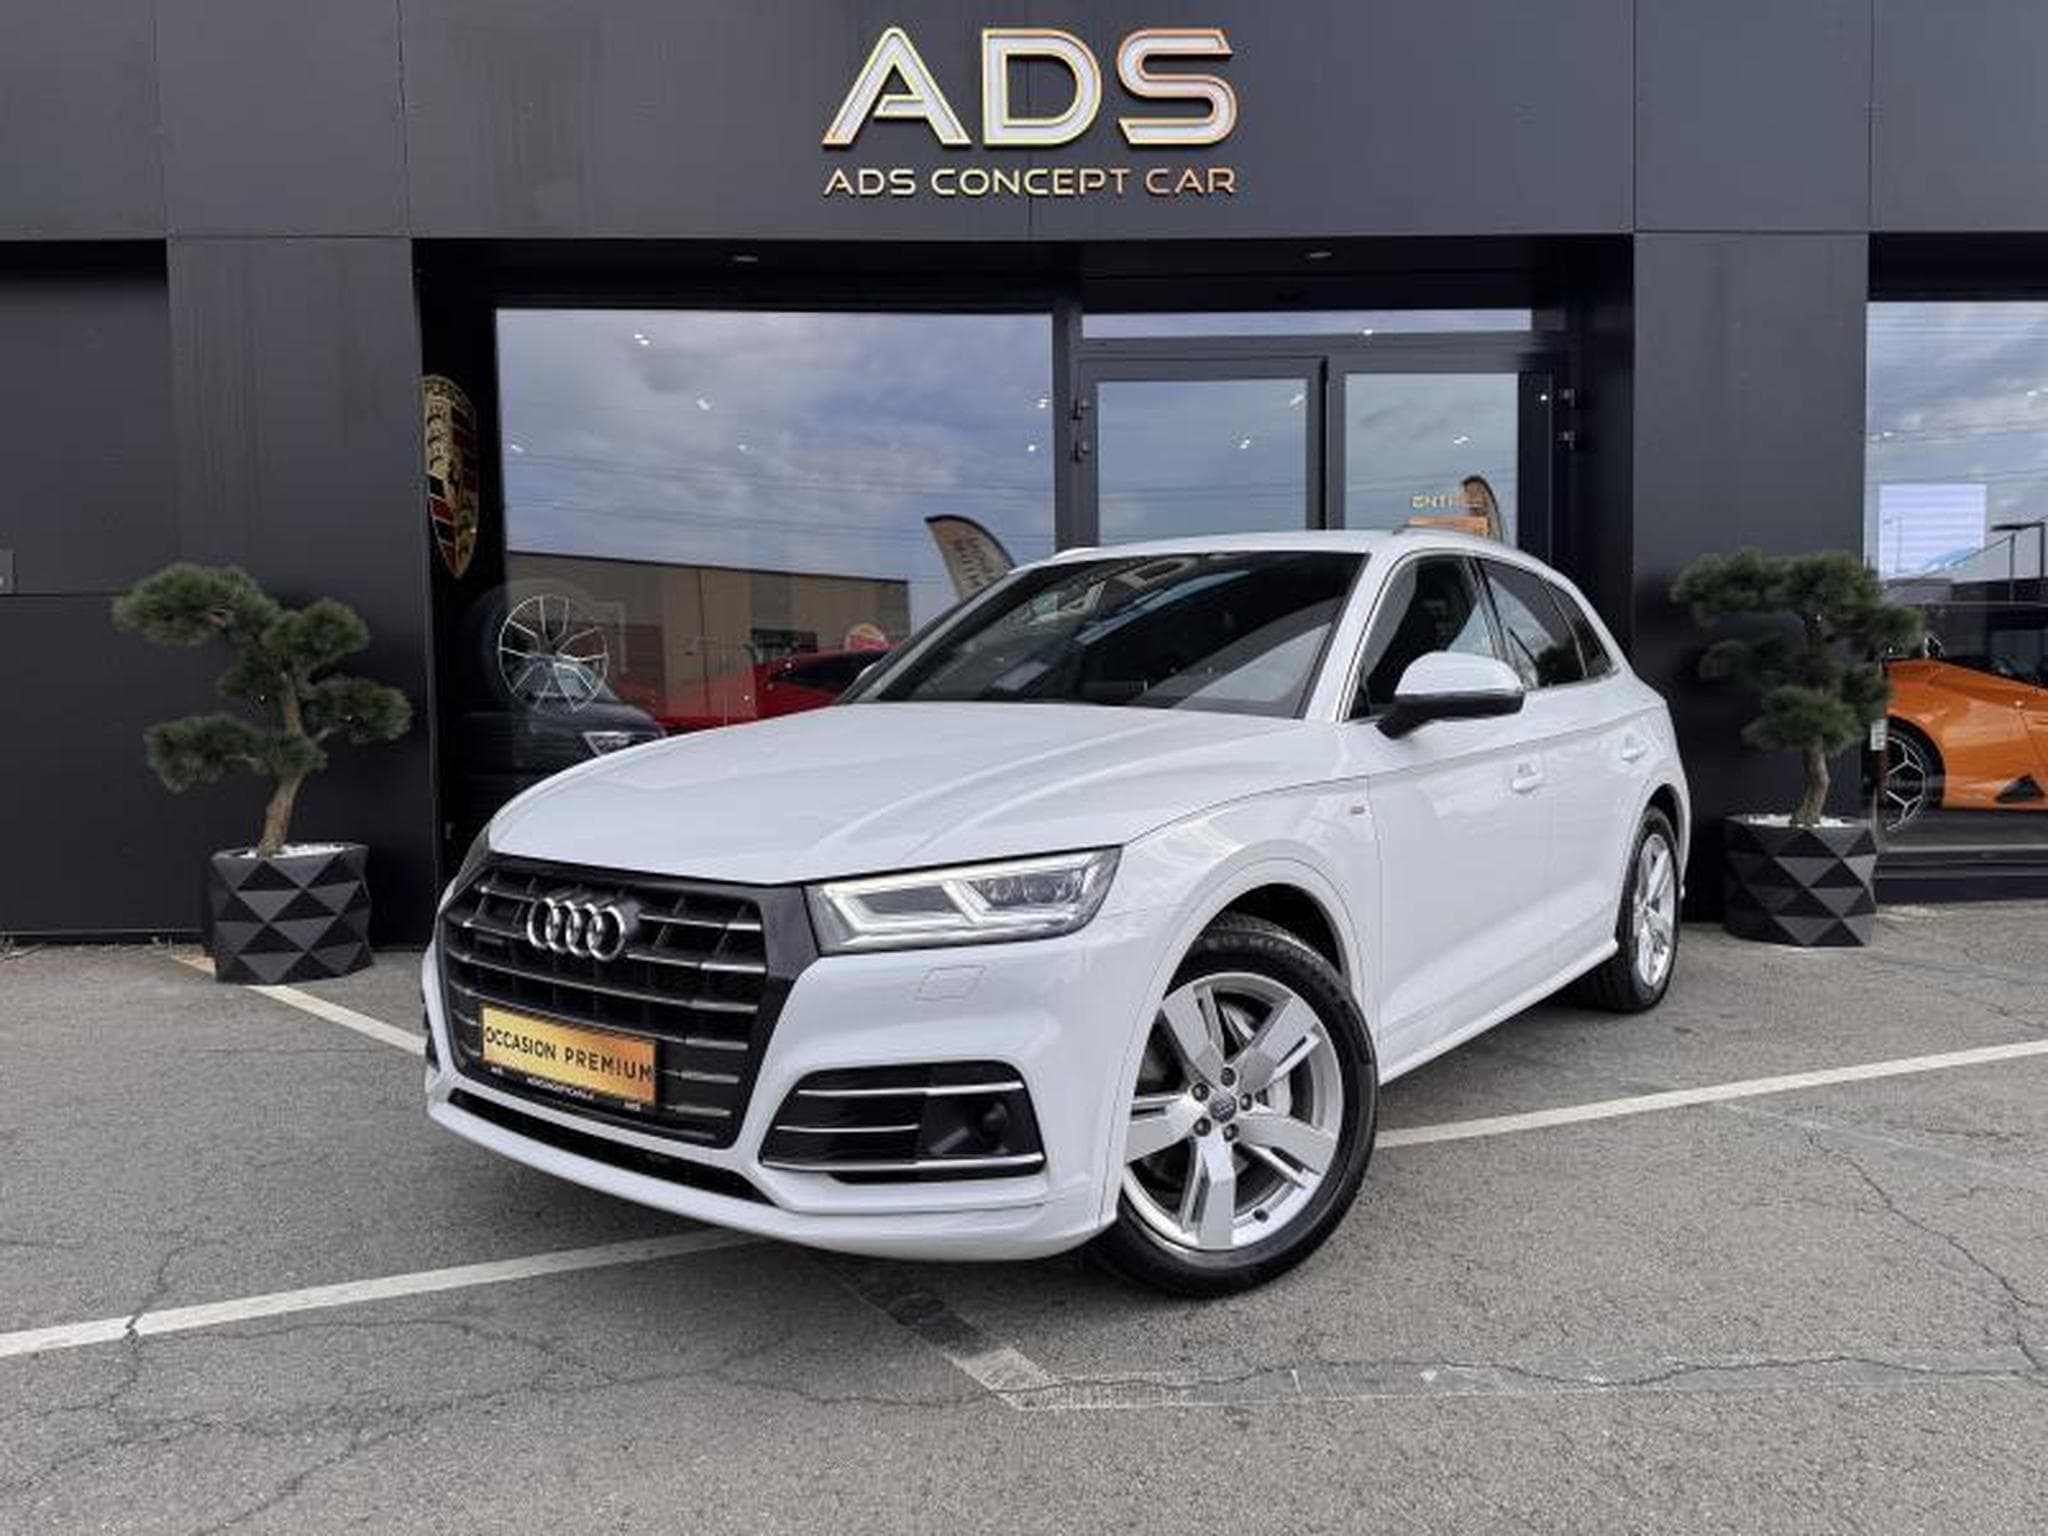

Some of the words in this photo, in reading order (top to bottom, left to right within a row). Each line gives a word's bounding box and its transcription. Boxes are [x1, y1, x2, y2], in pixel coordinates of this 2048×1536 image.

[822, 26, 1238, 146] ADS
[823, 168, 916, 195] ADS
[931, 168, 1130, 196] CONCEPT
[1146, 168, 1238, 194] CAR
[485, 1025, 556, 1061] OCCASION
[564, 1046, 653, 1082] PREMIUM
